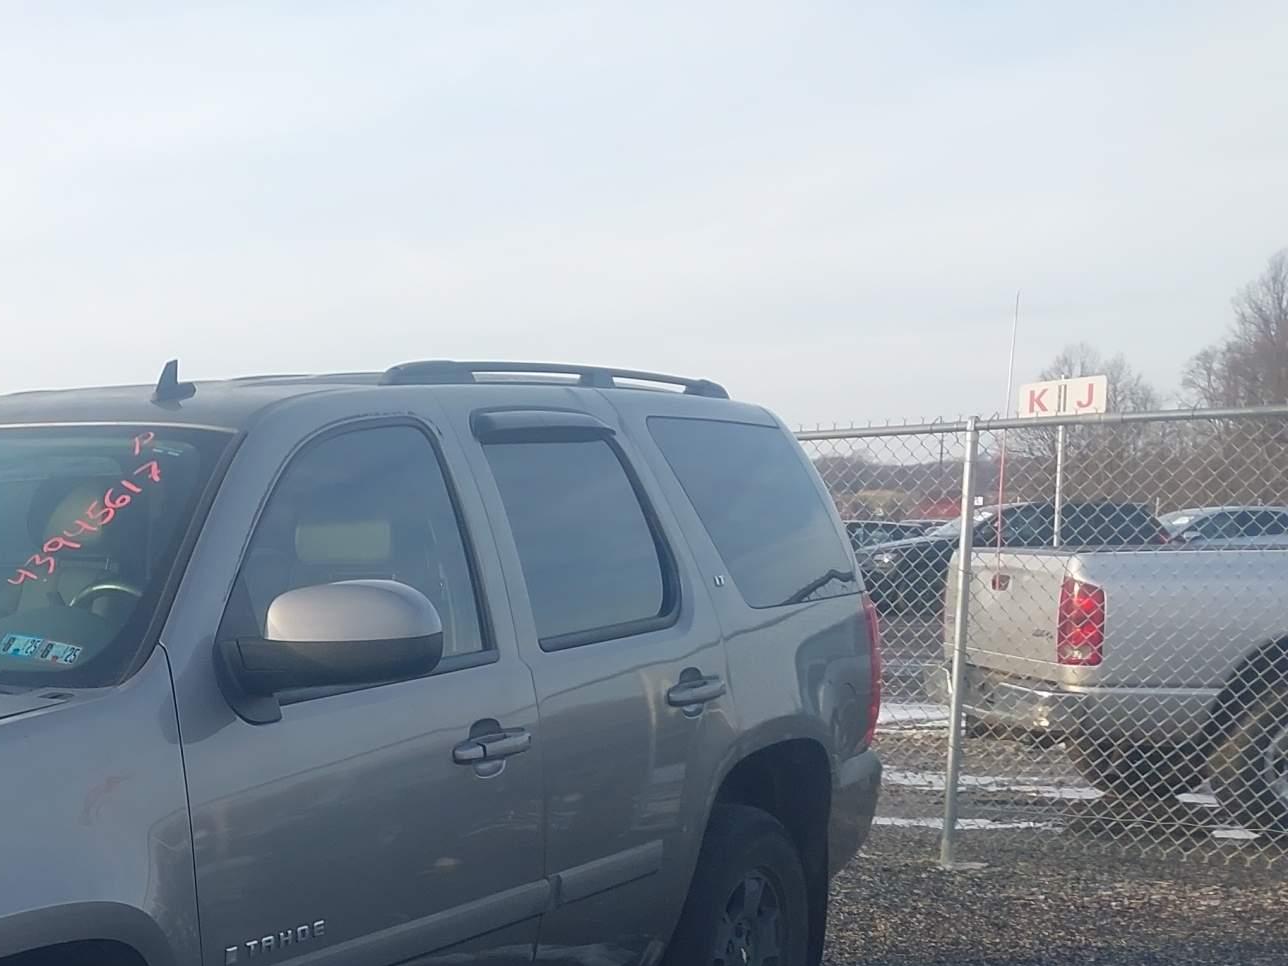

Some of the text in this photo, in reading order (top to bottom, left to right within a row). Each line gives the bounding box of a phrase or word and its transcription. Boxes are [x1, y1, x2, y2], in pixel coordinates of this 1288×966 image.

[1028, 383, 1095, 414] K J
[7, 460, 161, 585] 43945617
[245, 920, 325, 958] TAHOE
